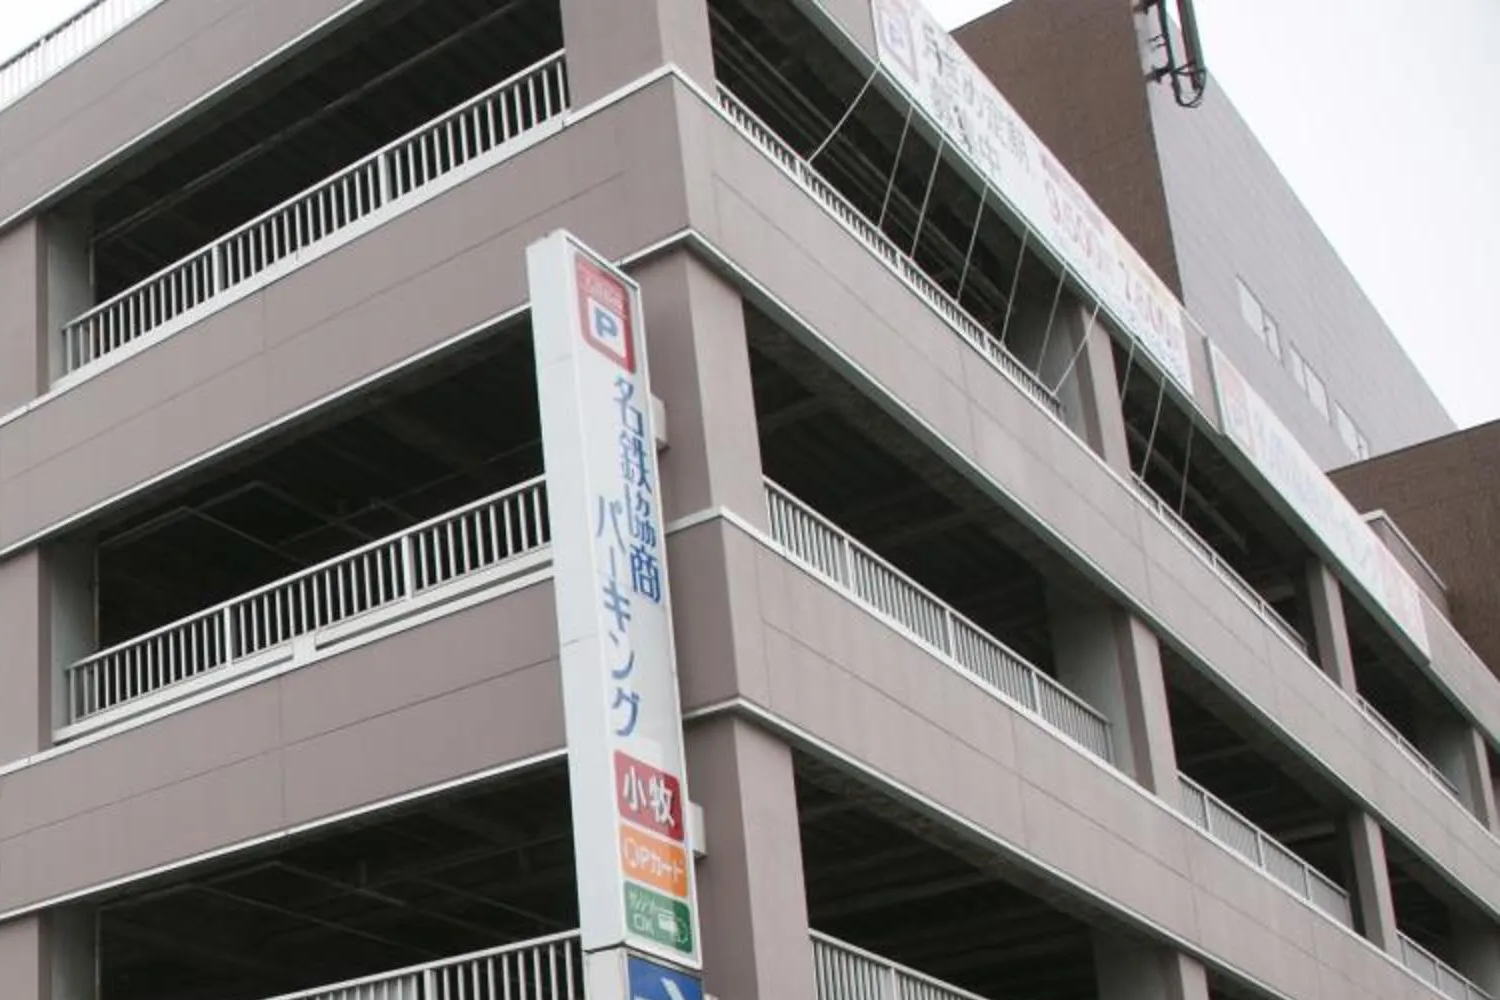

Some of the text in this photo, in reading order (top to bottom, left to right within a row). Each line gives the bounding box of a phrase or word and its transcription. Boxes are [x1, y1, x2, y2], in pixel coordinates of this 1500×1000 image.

[595, 307, 618, 337] P
[613, 376, 661, 604] 名鉄協商
[597, 495, 640, 737] パーキング
[623, 765, 675, 828] 小牧
